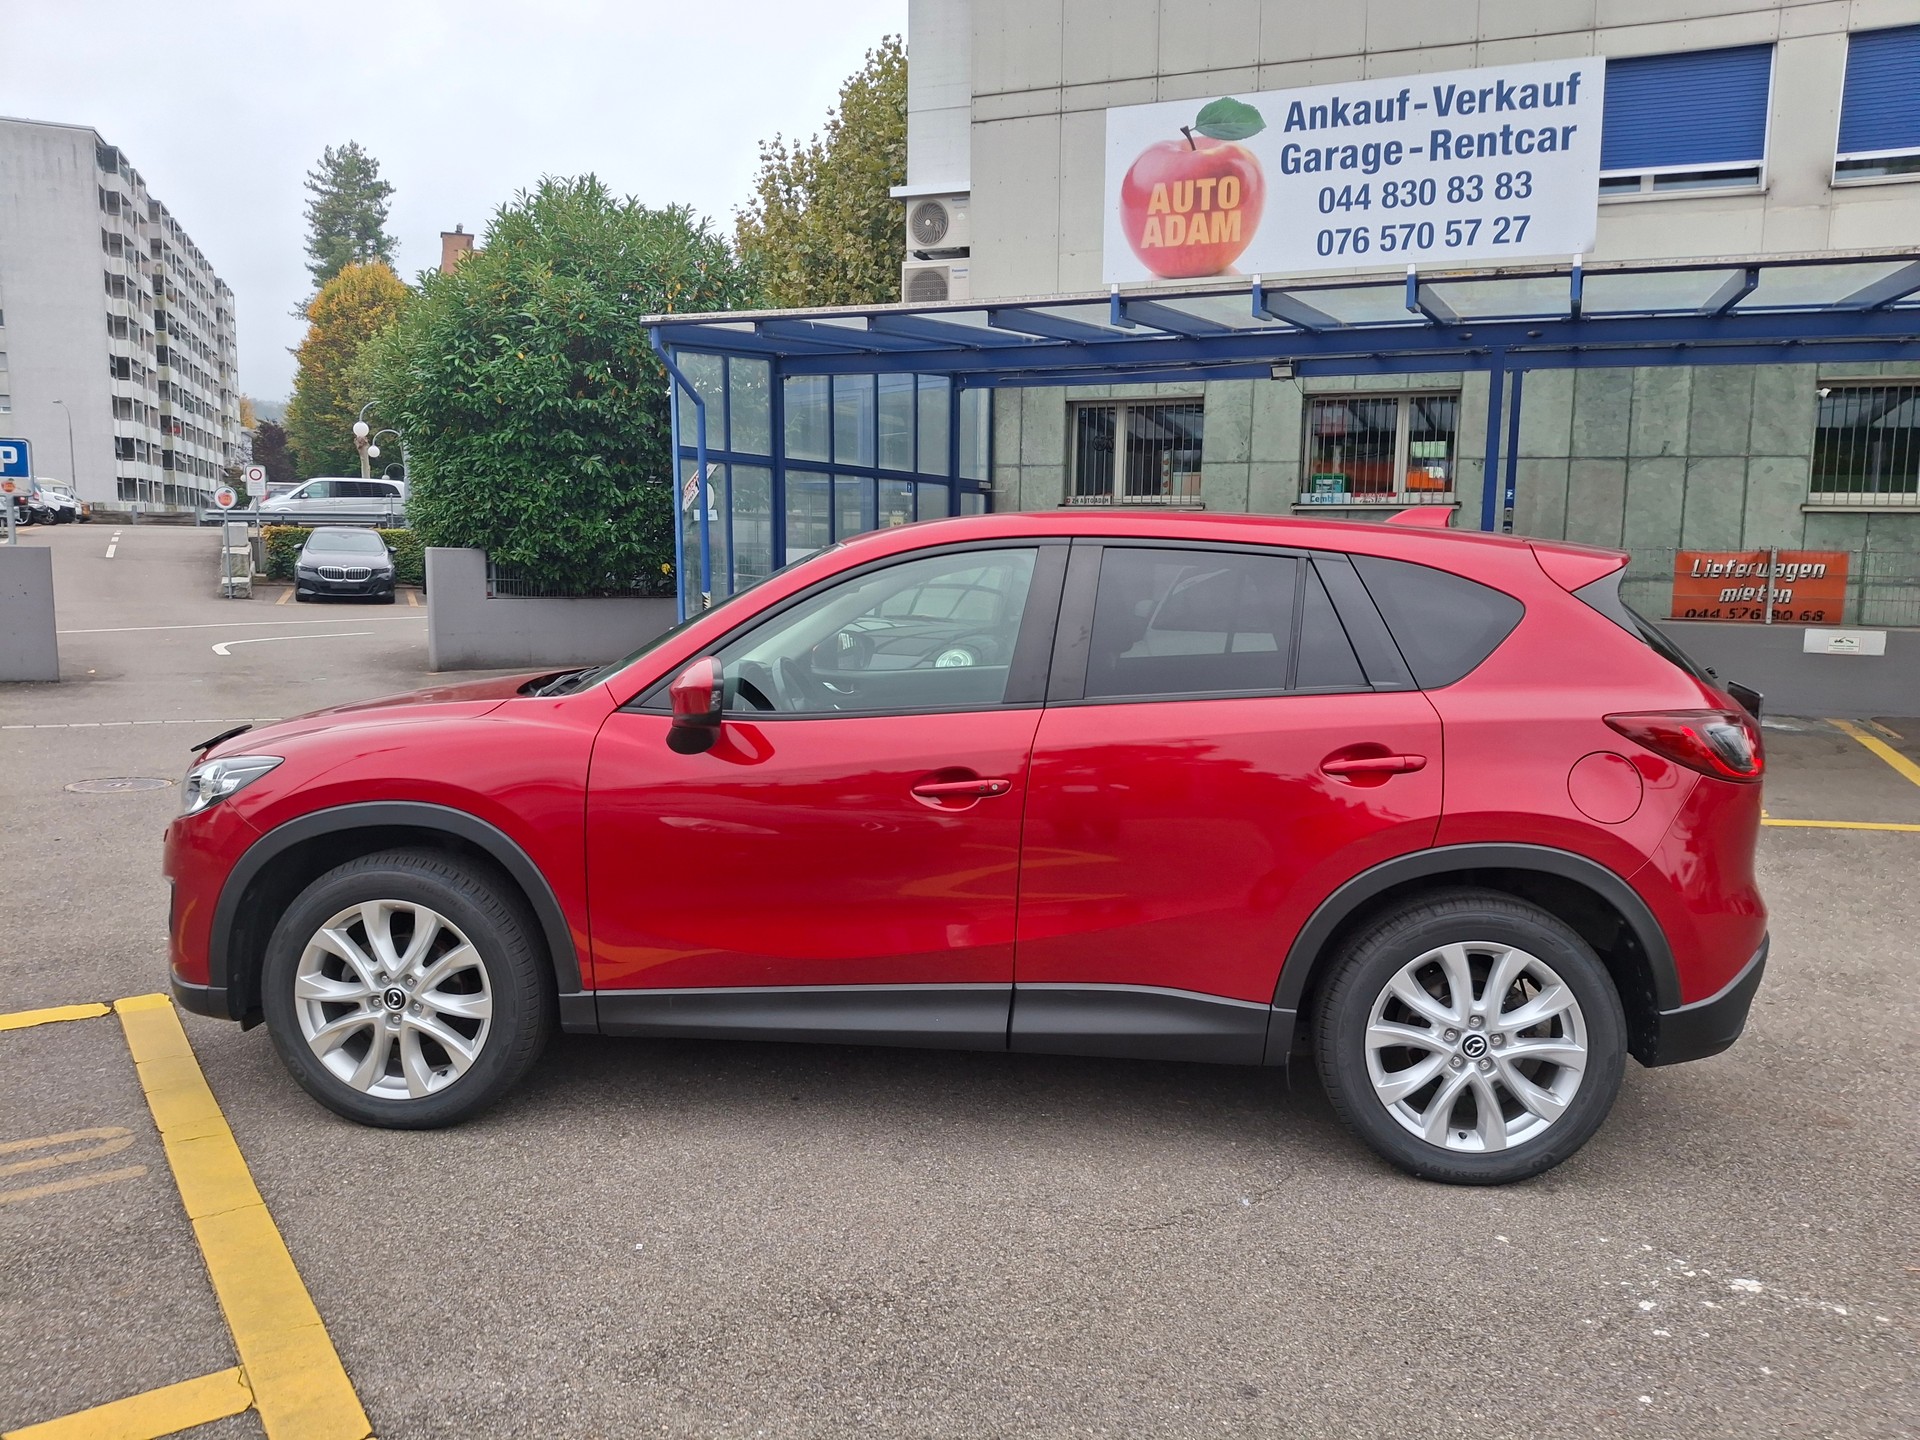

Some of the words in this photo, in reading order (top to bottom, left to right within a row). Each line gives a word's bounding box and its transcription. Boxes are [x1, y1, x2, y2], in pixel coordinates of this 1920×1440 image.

[1283, 71, 1582, 133] Ankauf-Verkauf
[1280, 124, 1578, 175] Garage-Rentcar
[1147, 175, 1241, 216] AUTO
[1318, 183, 1372, 214] 044
[1381, 177, 1437, 209] 830
[1446, 174, 1484, 204] 83
[1494, 170, 1533, 201] 83
[1140, 209, 1242, 249] ADAM
[1316, 226, 1371, 257] 076
[1379, 221, 1435, 252] 570
[1444, 218, 1483, 248] 57
[1492, 214, 1532, 245] 27
[0, 446, 18, 473] P
[1310, 494, 1342, 503] Cemba
[1690, 559, 1827, 582] Lieferwagen
